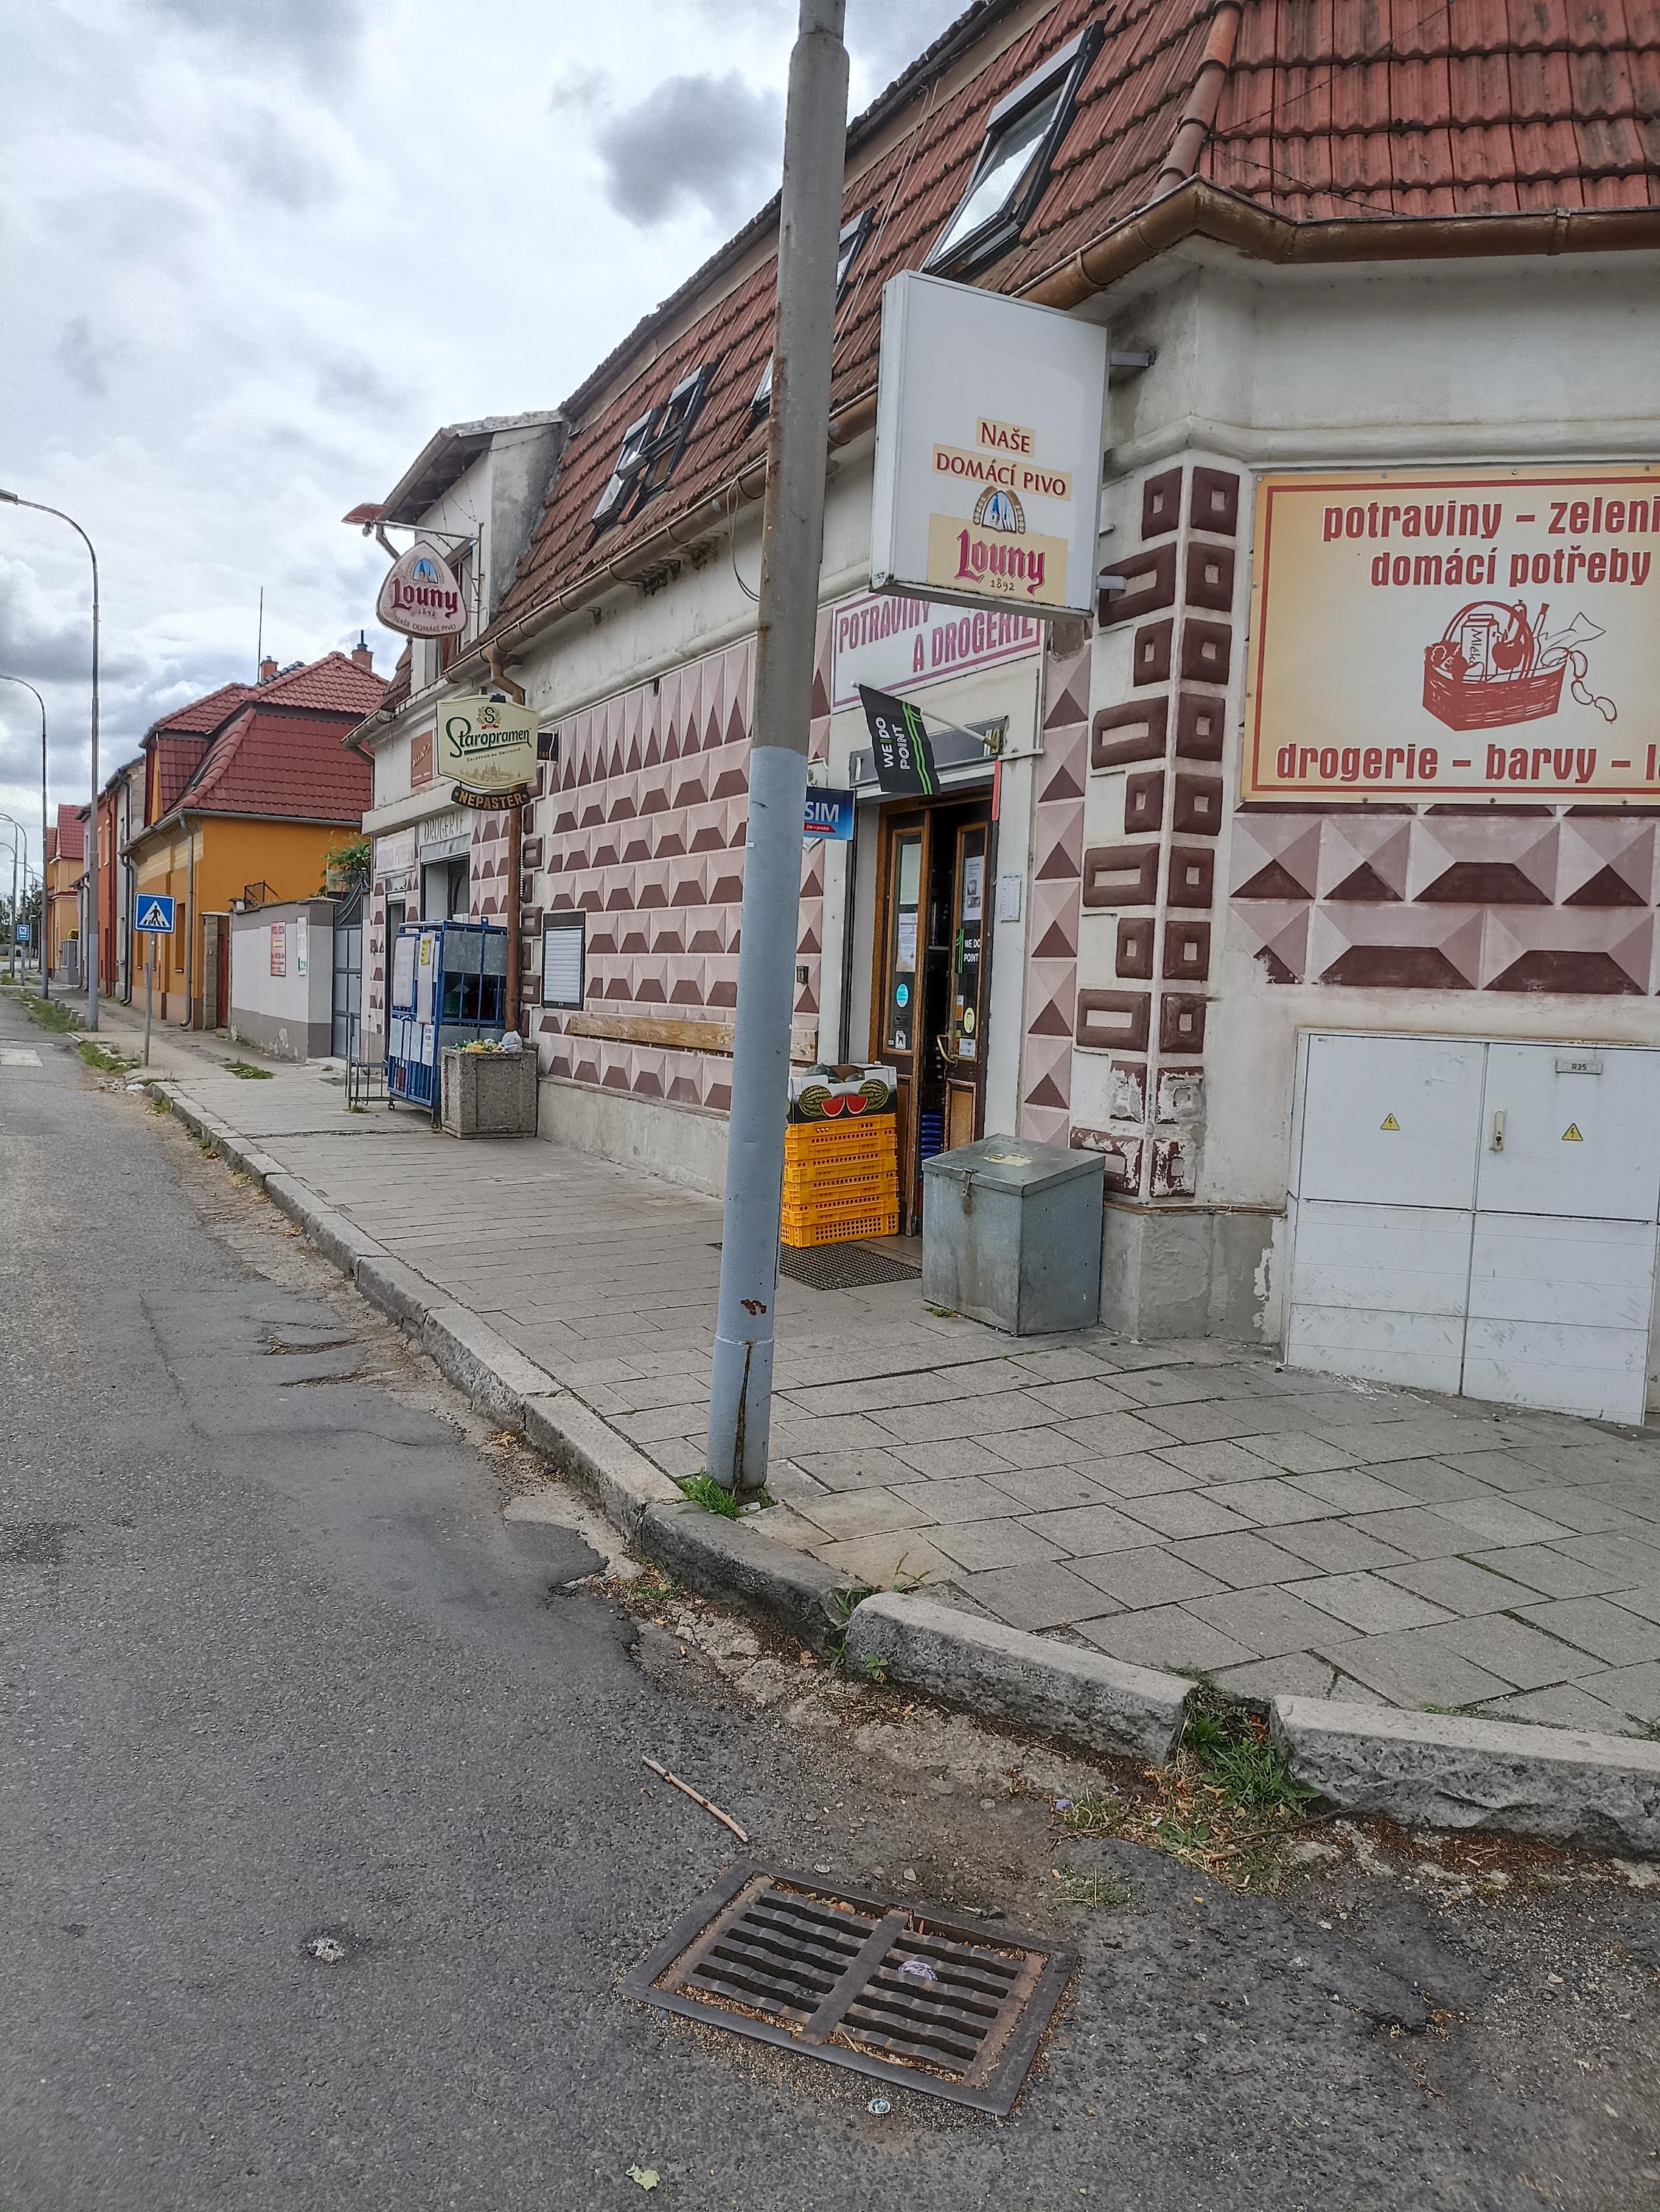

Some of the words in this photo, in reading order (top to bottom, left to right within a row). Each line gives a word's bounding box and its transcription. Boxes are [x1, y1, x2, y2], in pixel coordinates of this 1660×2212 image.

[981, 422, 1030, 453] NAŠE
[936, 453, 1017, 486] DOMÁCÍ
[1023, 472, 1067, 496] PIVO
[1323, 500, 1502, 542] potraviny
[1548, 495, 1660, 534] zeleni
[955, 528, 1045, 595] Louny
[1371, 547, 1498, 586] domácí
[1509, 545, 1651, 588] potřeby
[391, 577, 458, 619] Louny
[990, 579, 1015, 591] 1892
[419, 608, 436, 616] 1892
[839, 597, 930, 653] POTRAVINY
[913, 634, 924, 672] A
[932, 611, 1033, 667] DROGERIE
[446, 717, 530, 758] Staropramen
[892, 724, 910, 770] POINT
[1277, 743, 1438, 782] drogerie
[1485, 744, 1597, 784] barvy
[458, 790, 524, 810] NEPASTER
[804, 801, 839, 822] SIM
[963, 953, 979, 962] POINT
[1572, 1063, 1586, 1071] R35
